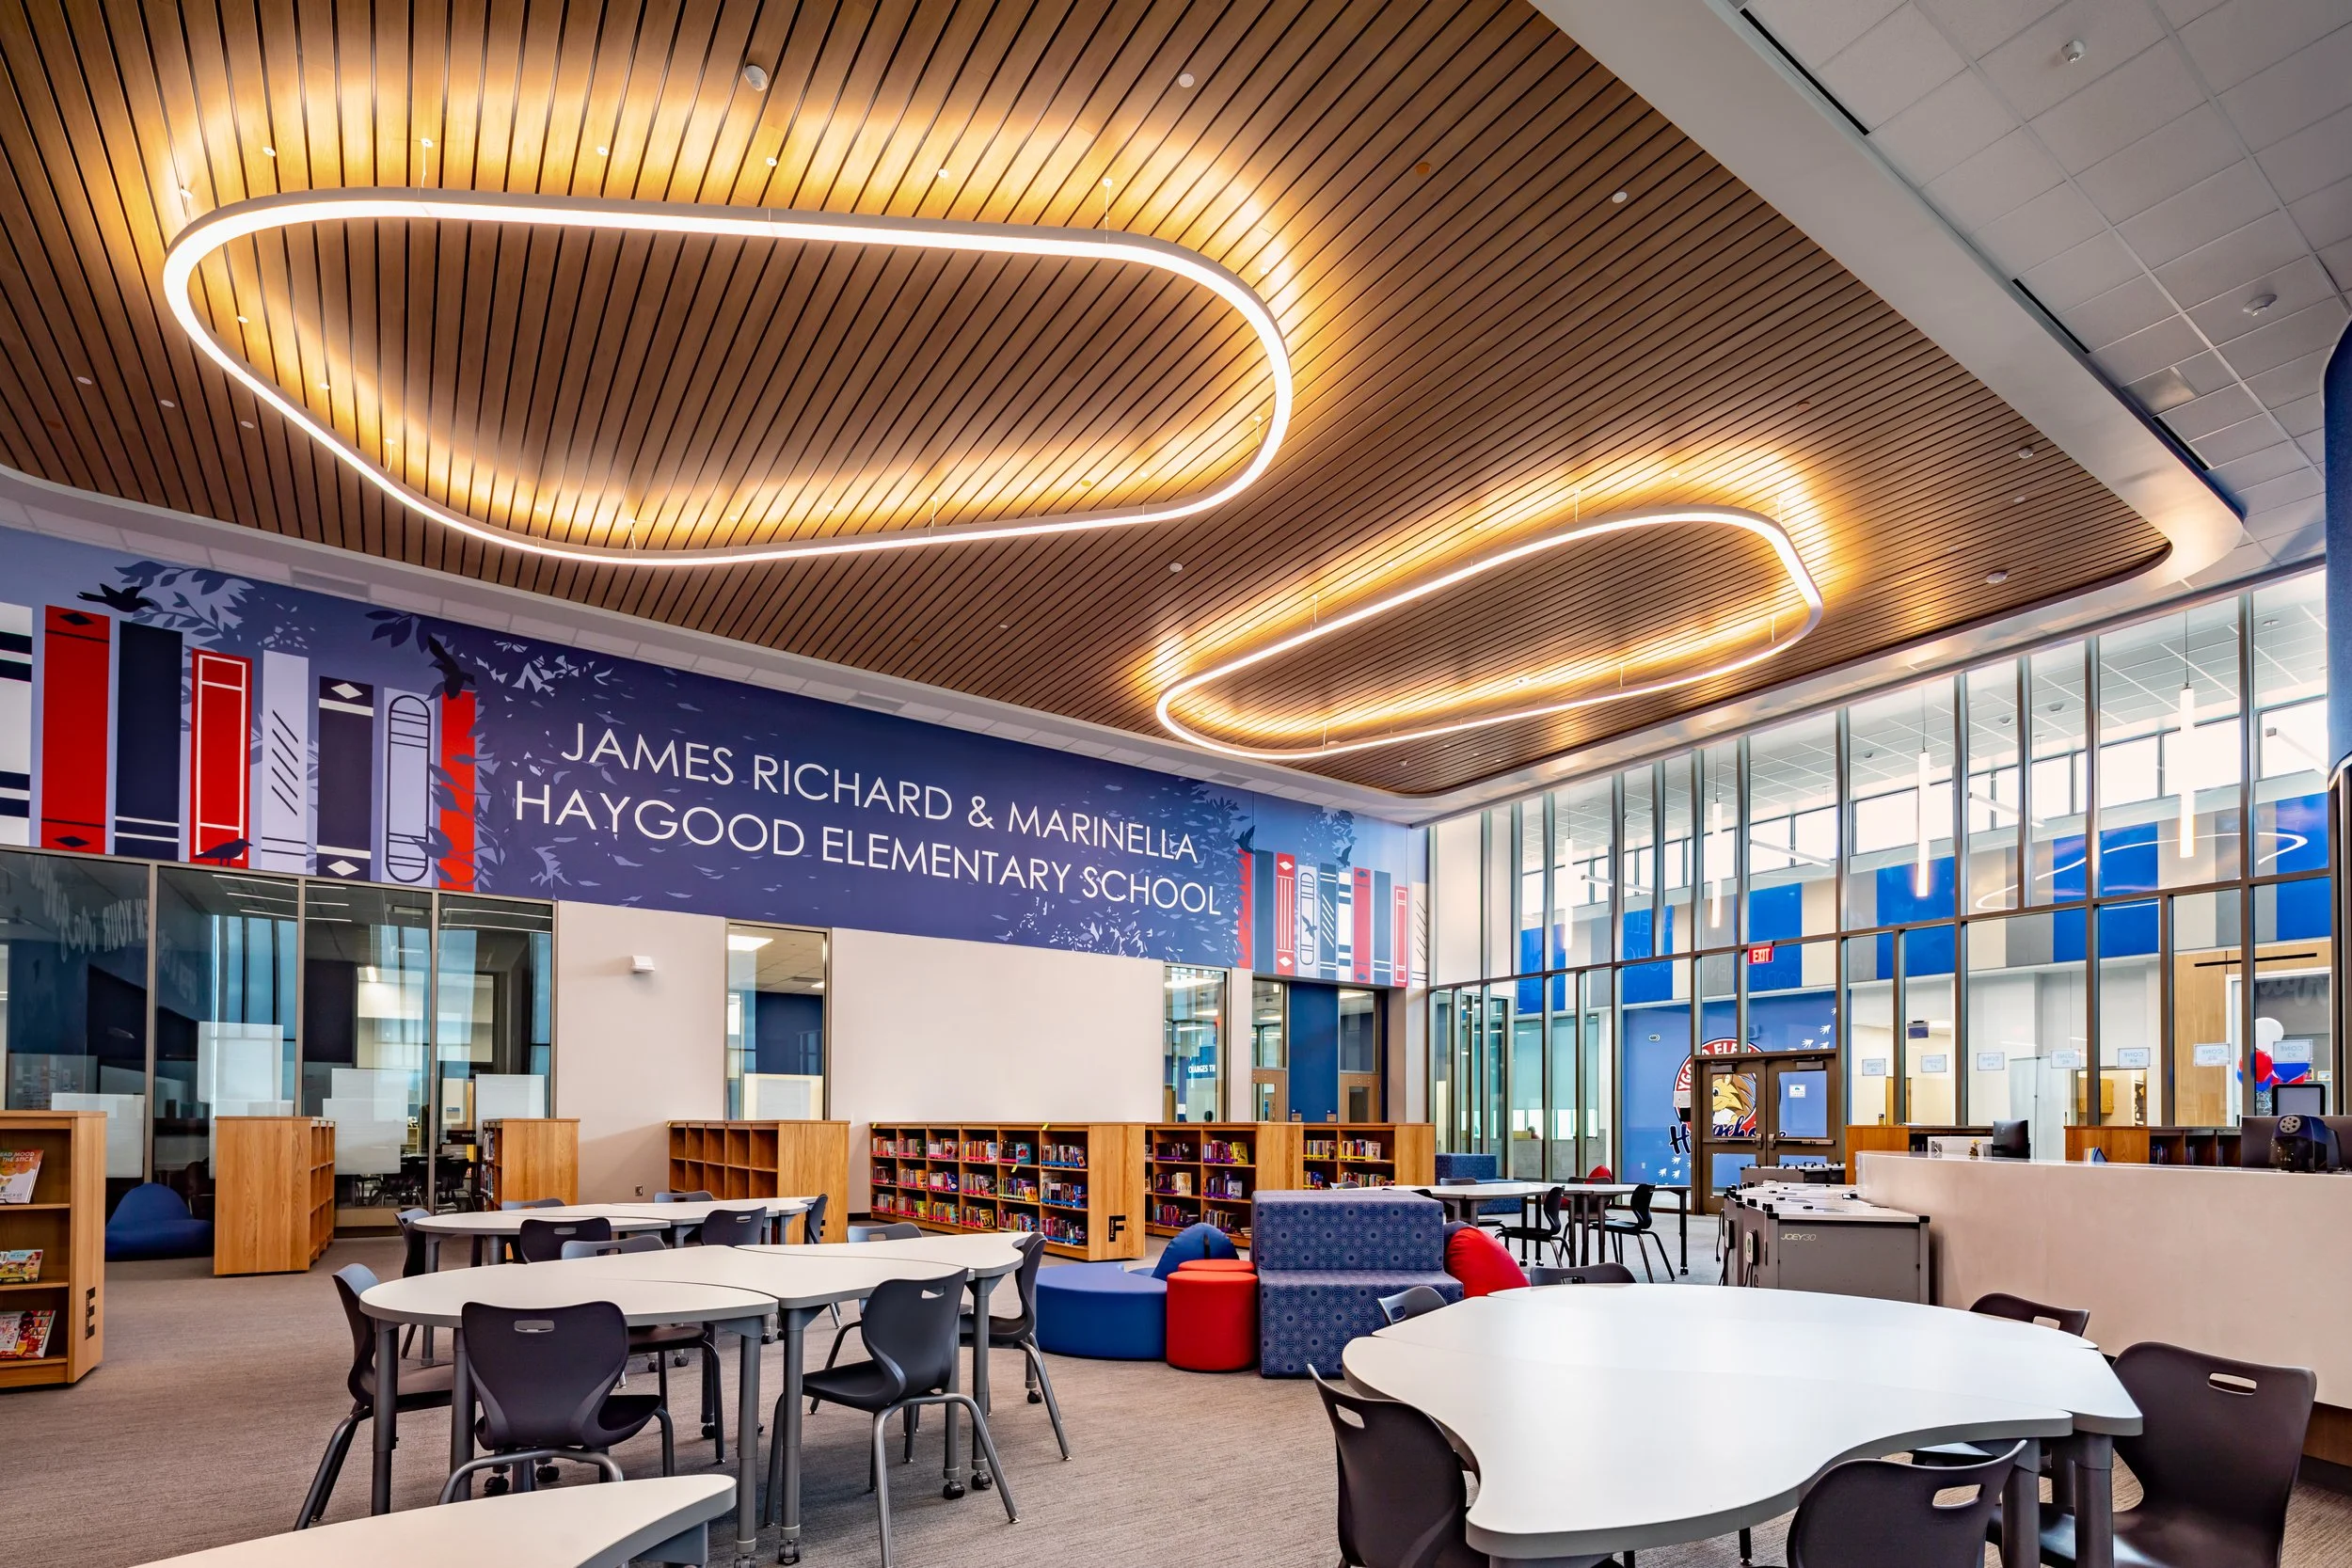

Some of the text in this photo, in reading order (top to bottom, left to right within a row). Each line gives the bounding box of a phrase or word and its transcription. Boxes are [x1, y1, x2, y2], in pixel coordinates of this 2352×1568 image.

[562, 723, 1199, 863] JAMES RICHARD & MARINELLA
[516, 781, 1221, 916] HAYGOOD ELEMENTARY SCHOOL
[1753, 948, 1771, 963] EXIT
[1188, 1065, 1209, 1074] CHANGES
[1108, 1214, 1126, 1243] F
[85, 1287, 96, 1340] E
